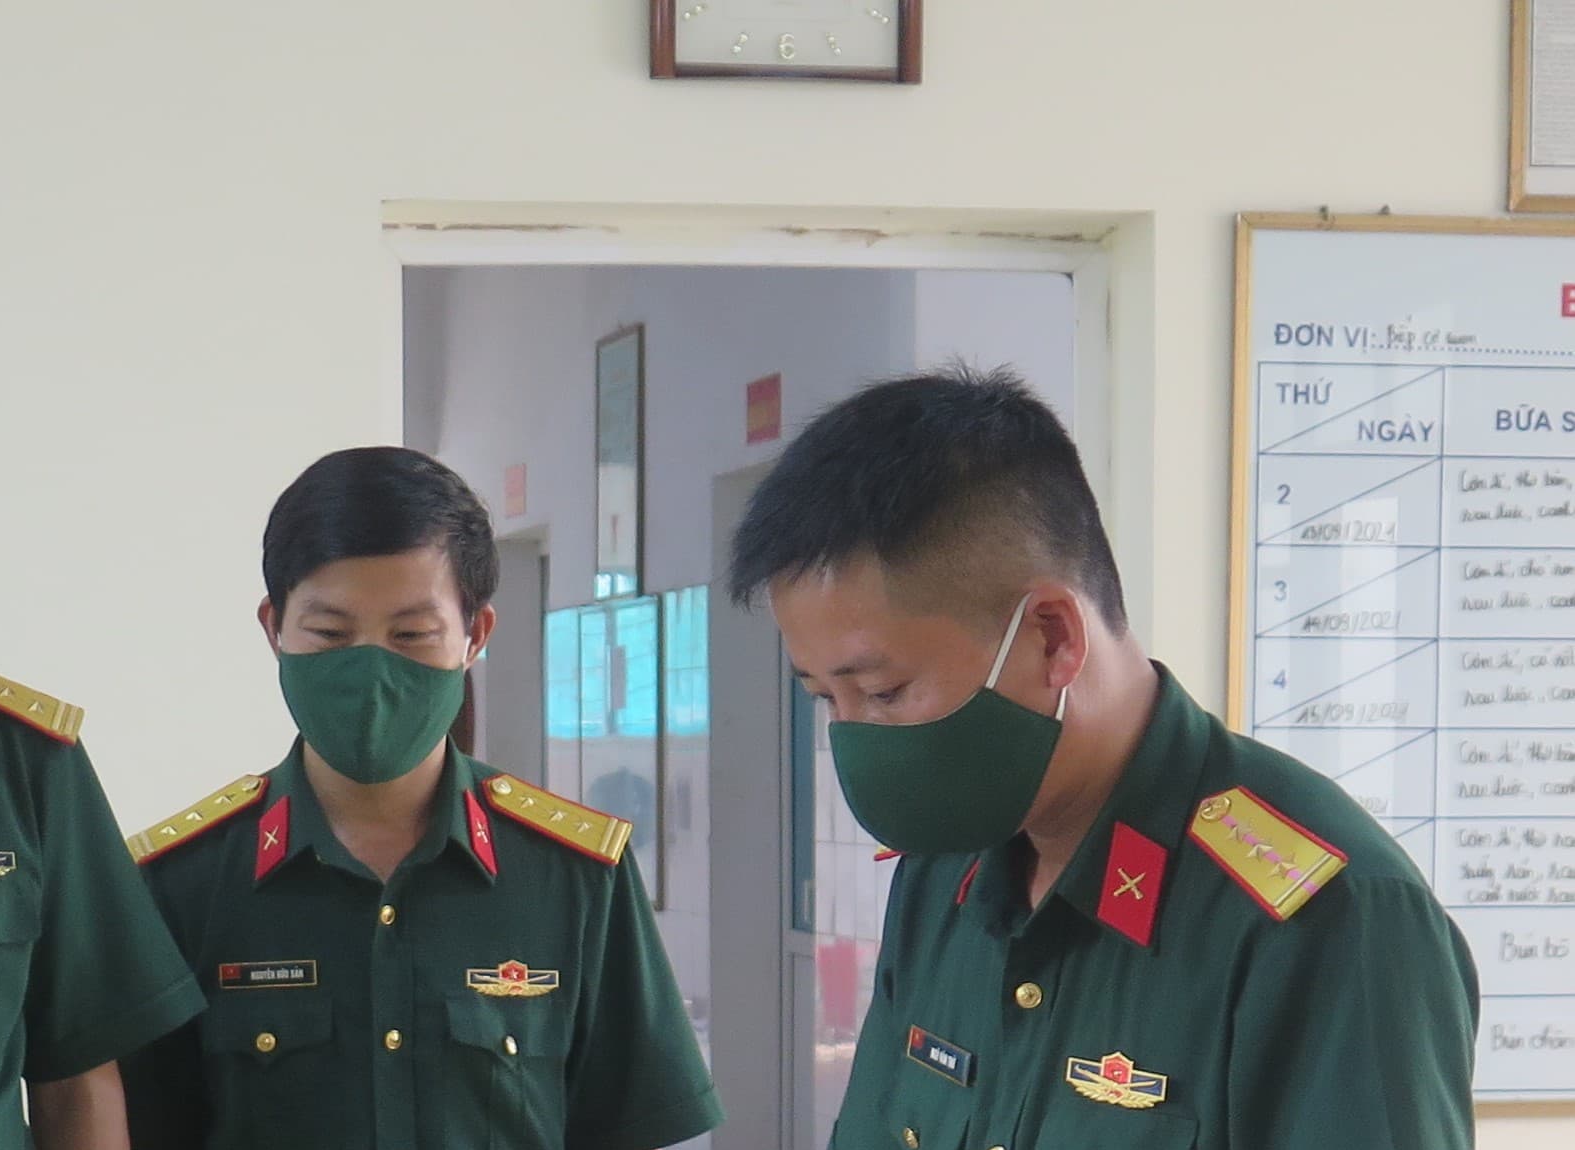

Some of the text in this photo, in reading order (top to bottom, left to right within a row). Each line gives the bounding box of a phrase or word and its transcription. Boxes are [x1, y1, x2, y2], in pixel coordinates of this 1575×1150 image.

[1275, 322, 1334, 348] ĐƠN
[1277, 378, 1332, 405] THỨ
[1358, 414, 1435, 442] NGÀY
[1496, 403, 1552, 432] BỮA
[1277, 483, 1291, 505] 2
[1274, 579, 1288, 602] 3
[1272, 669, 1287, 689] 4
